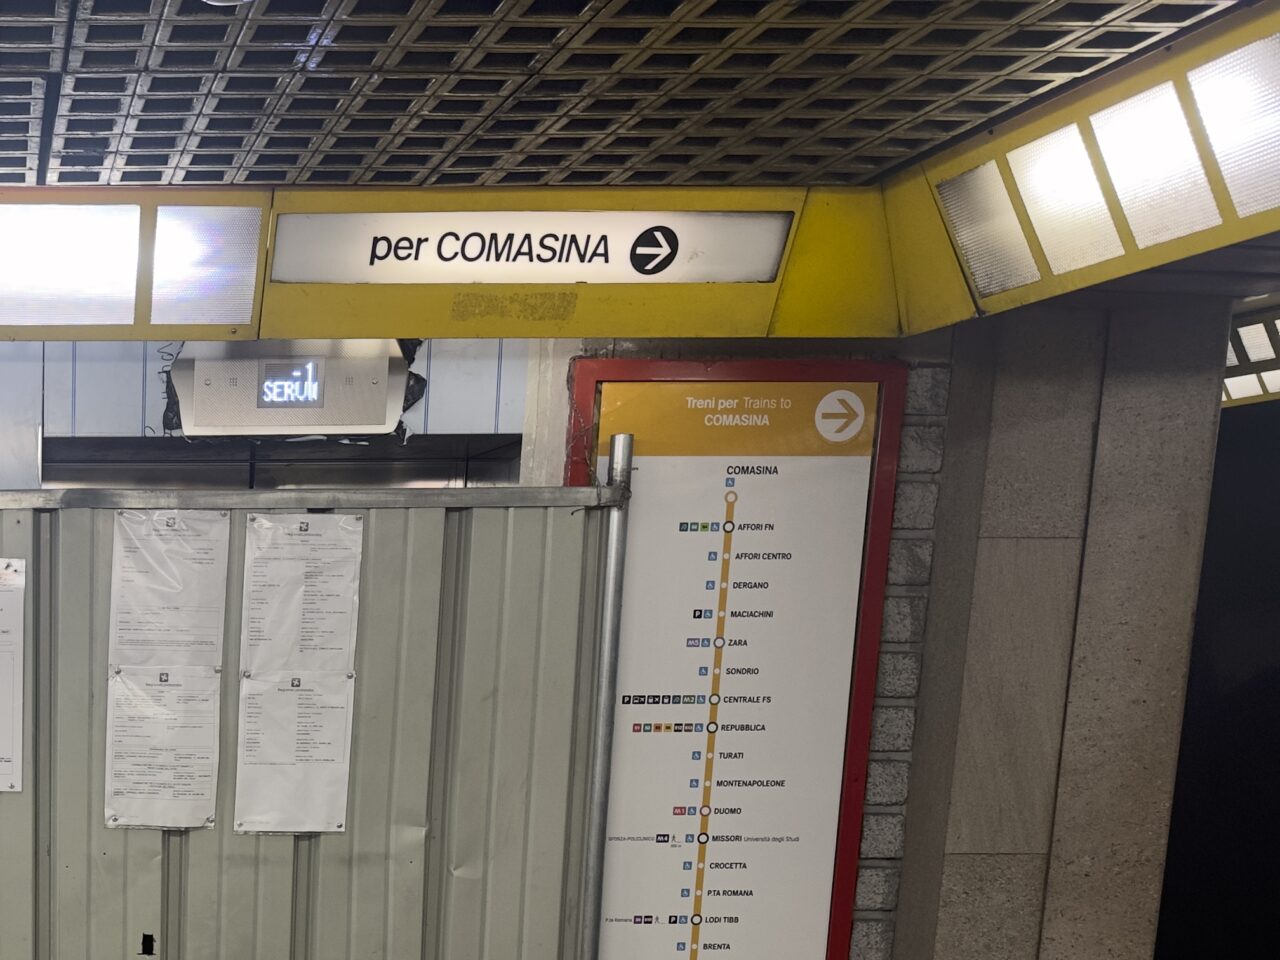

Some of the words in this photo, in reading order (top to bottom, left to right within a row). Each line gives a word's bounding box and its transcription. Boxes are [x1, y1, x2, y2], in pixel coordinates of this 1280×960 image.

[369, 234, 428, 266] per
[436, 232, 610, 264] COMASINA
[686, 396, 715, 409] Treni
[718, 399, 737, 412] per
[743, 397, 776, 409] Trains
[780, 398, 792, 409] to
[704, 414, 769, 426] COMASINA
[726, 465, 779, 475] COMASINA
[728, 639, 748, 647] ZARA
[720, 724, 766, 732] REPUBBLICA
